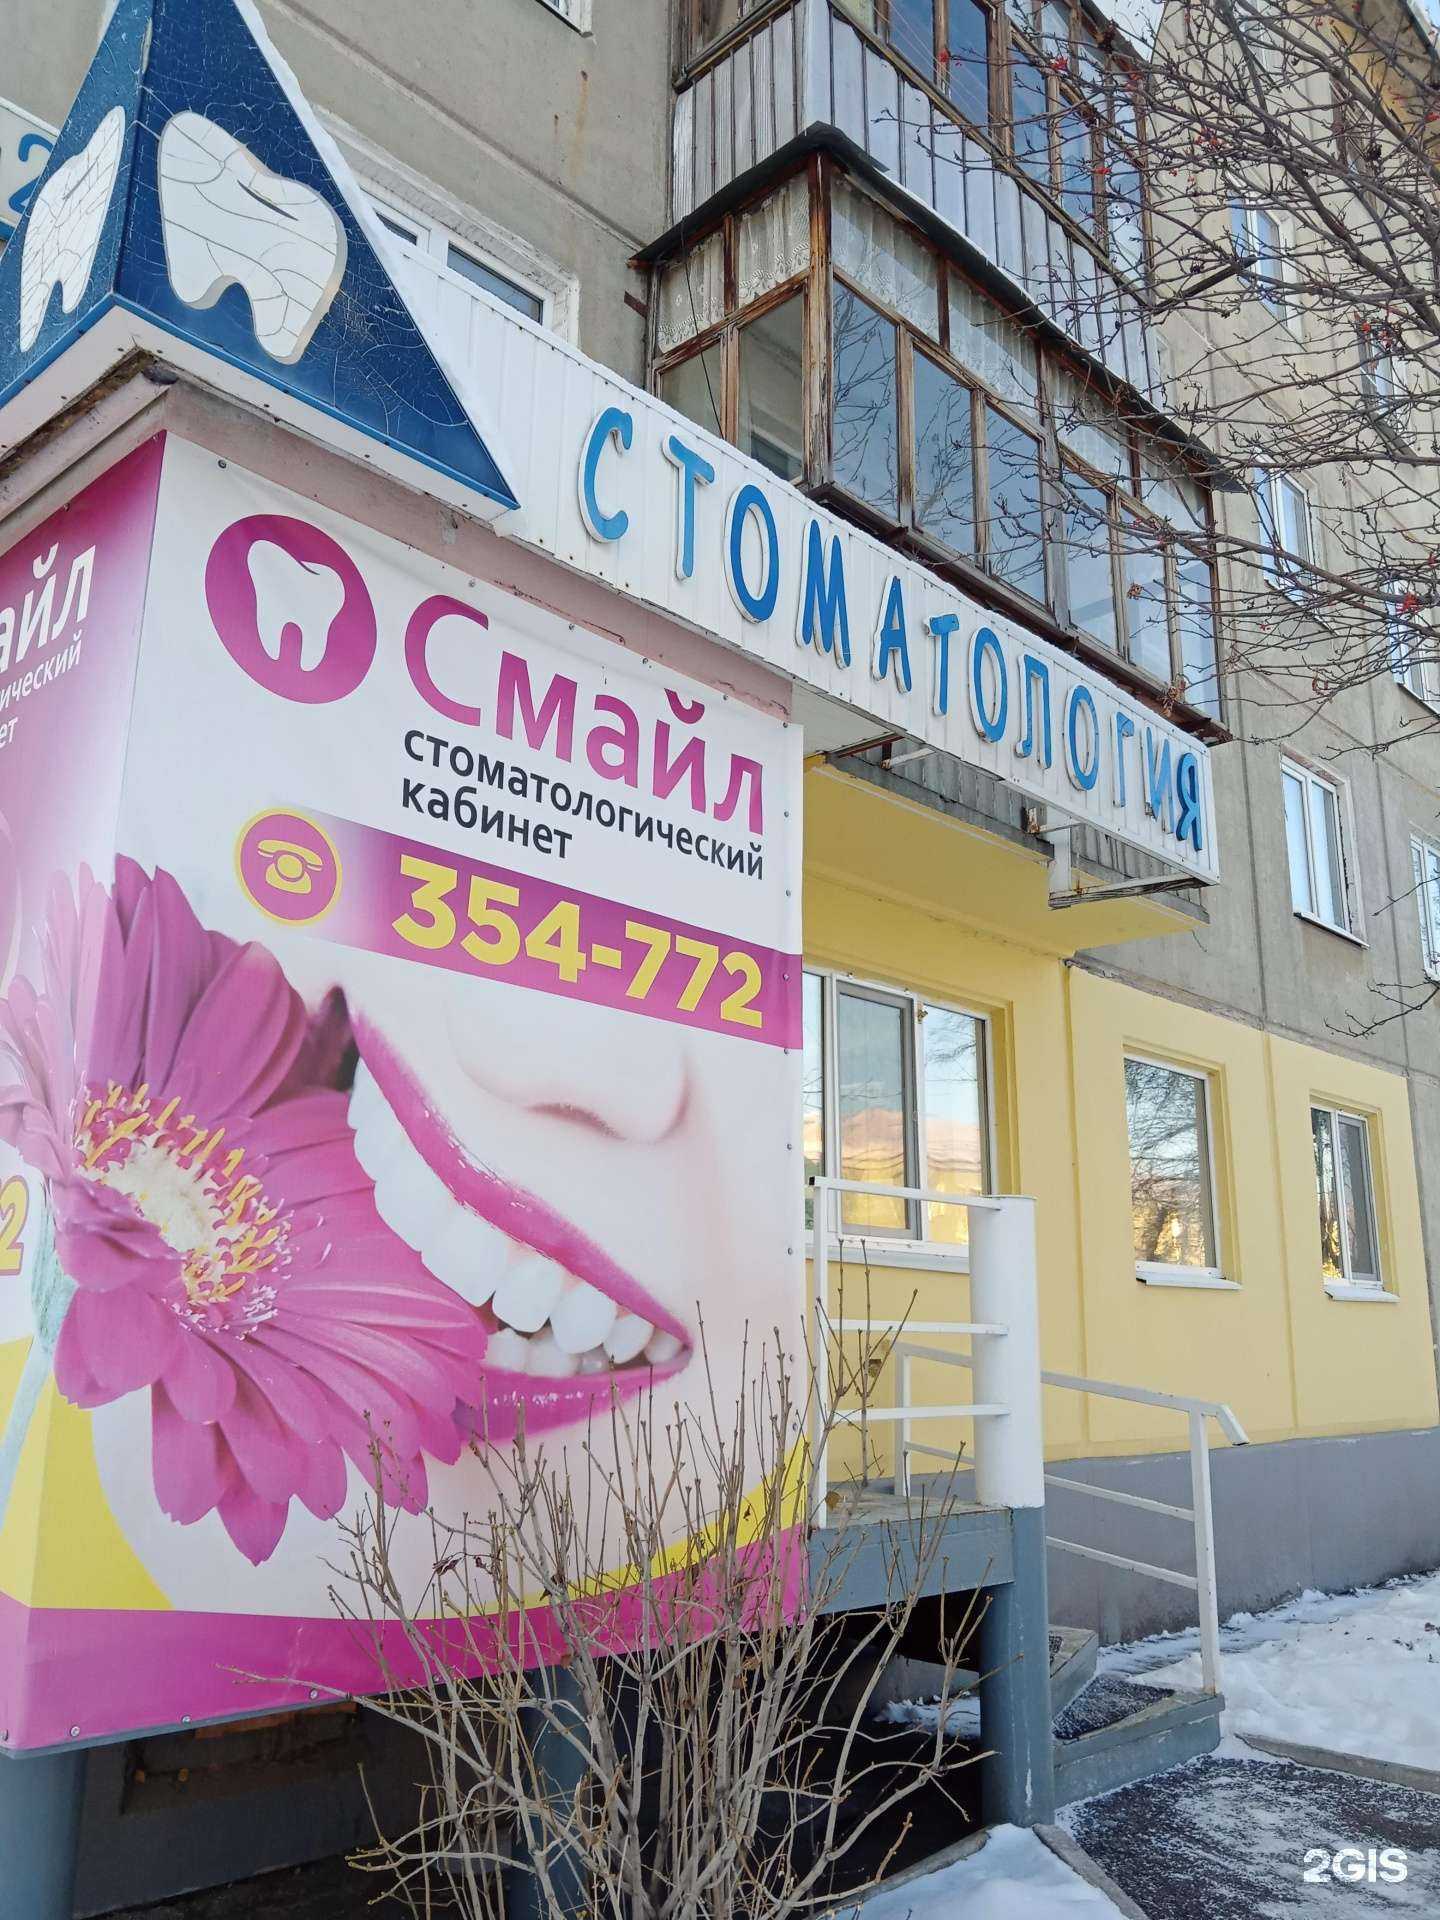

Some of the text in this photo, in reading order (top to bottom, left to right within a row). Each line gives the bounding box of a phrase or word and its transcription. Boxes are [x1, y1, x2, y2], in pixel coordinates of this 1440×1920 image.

[403, 594, 764, 836] Смайл
[580, 407, 1204, 852] СТОМАТОЛОГИЯ
[402, 778, 573, 859] кабинет
[403, 729, 764, 881] стоматологический
[391, 853, 763, 1029] 354-772
